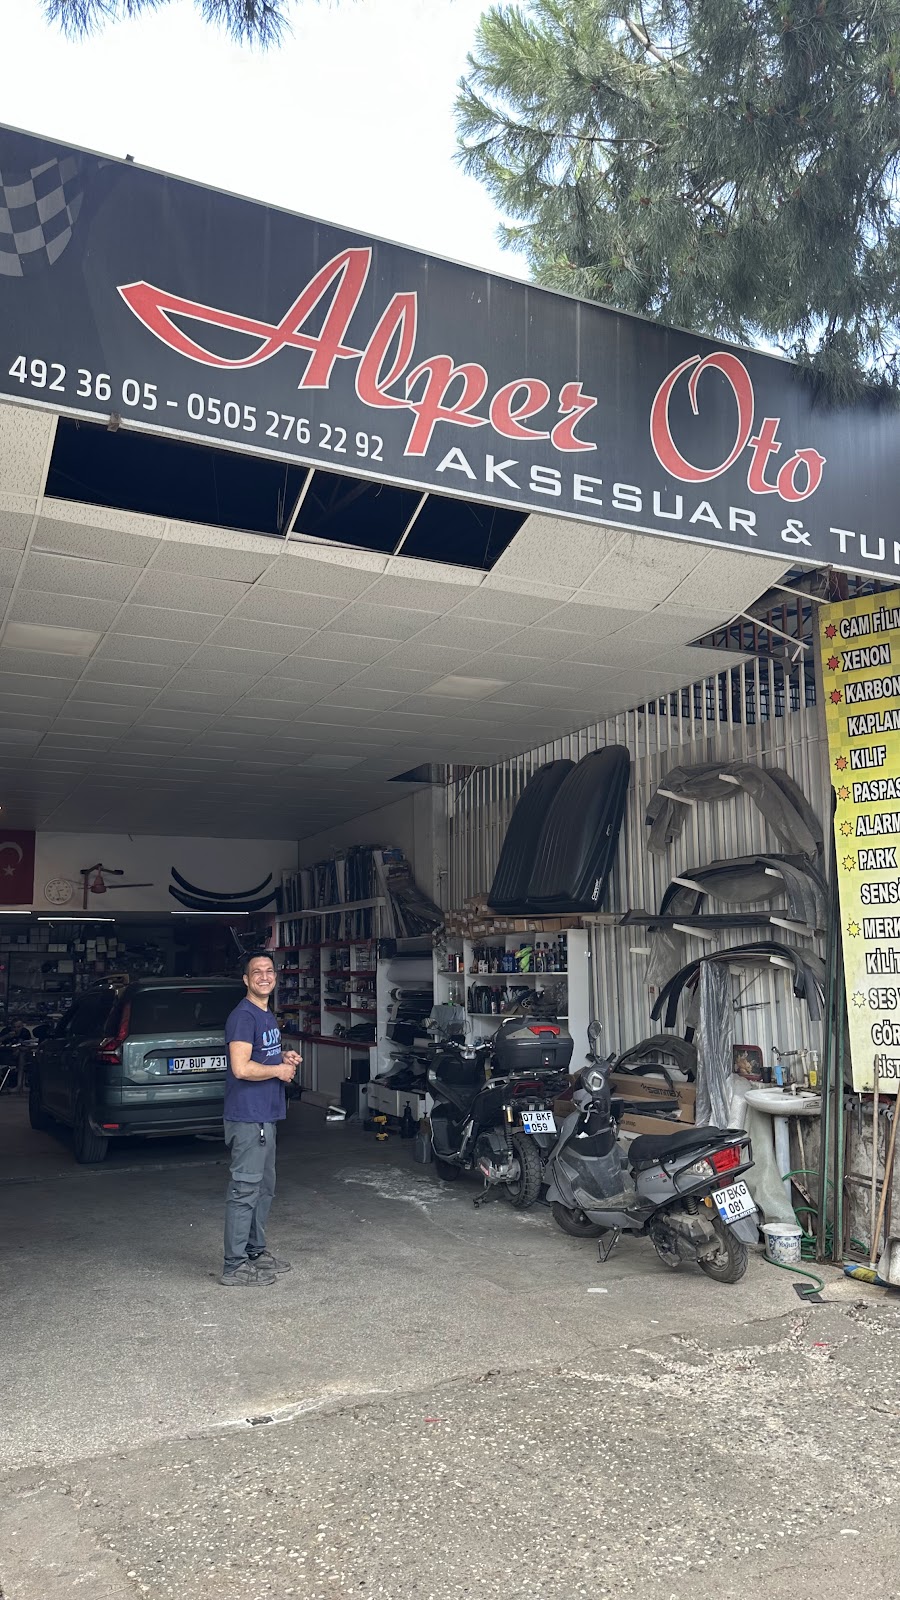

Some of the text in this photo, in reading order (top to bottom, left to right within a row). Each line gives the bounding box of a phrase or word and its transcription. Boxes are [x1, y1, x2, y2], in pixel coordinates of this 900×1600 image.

[117, 246, 827, 502] Alper Oto
[8, 355, 384, 462] 492 36 05 - 0505 276 22 92
[436, 447, 758, 537] AKSESUAR
[780, 519, 812, 545] &
[840, 614, 871, 639] CAM
[841, 643, 891, 672] XENON
[850, 745, 886, 770] KILIF
[858, 847, 898, 871] PARK
[860, 877, 900, 905] SENS
[868, 988, 897, 1010] SES
[174, 1056, 226, 1070] 07 BUP 731
[522, 1112, 551, 1121] 07 BKF
[531, 1122, 548, 1132] 059
[715, 1184, 747, 1205] 07 BKG
[728, 1199, 745, 1214] 081
